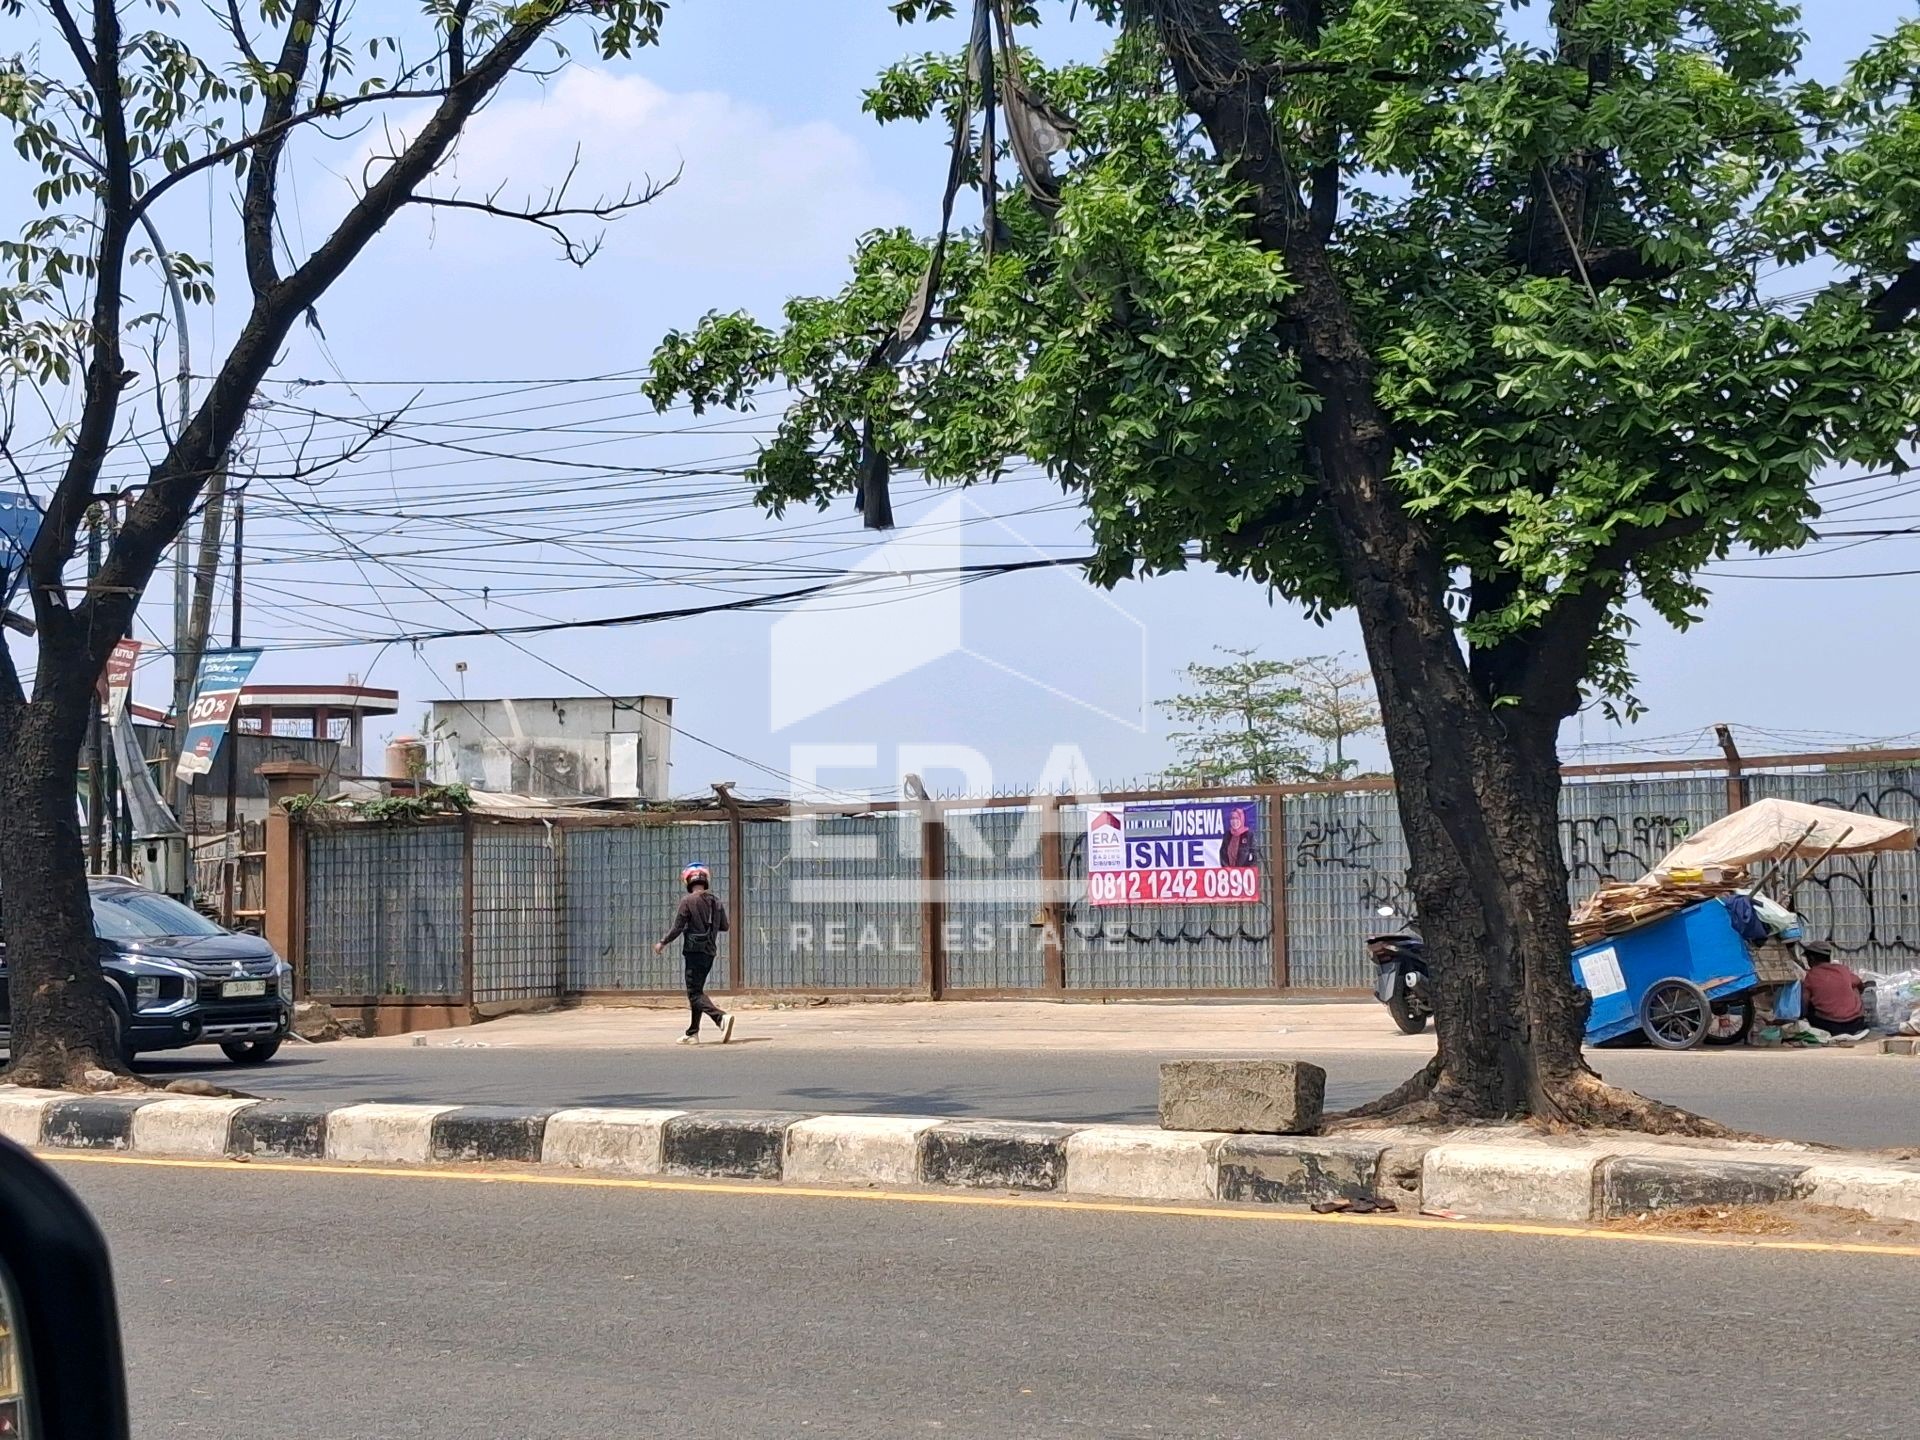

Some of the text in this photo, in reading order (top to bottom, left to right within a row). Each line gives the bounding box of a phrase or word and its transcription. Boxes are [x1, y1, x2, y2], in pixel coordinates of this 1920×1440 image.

[1092, 832, 1119, 845] ERA
[1125, 840, 1205, 869] ISNIE
[1091, 869, 1256, 899] 0812 1242 0890
